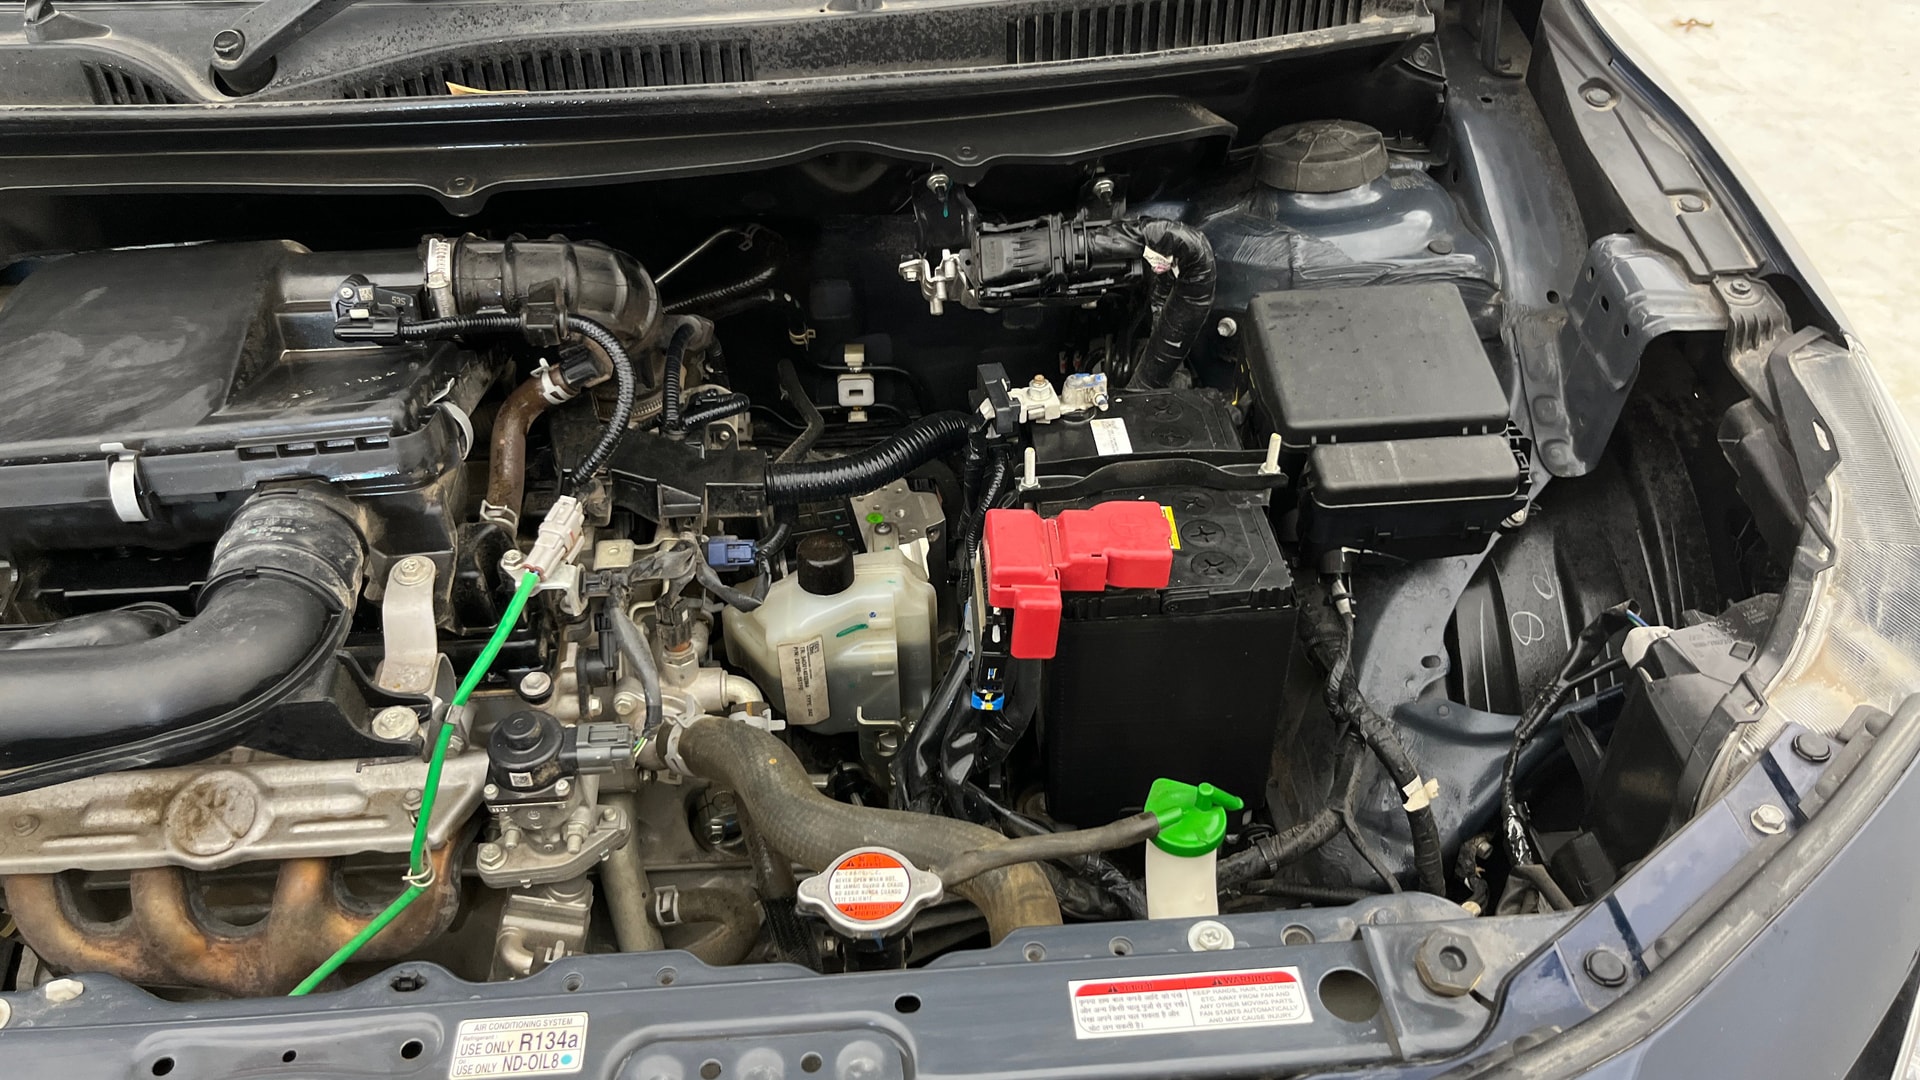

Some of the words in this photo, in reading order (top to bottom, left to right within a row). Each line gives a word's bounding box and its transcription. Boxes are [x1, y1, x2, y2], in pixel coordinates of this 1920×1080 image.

[1223, 974, 1273, 985] WARNING
[1243, 1005, 1298, 1014] AUTOMATICALLY
[474, 1024, 487, 1032] AIR
[488, 1020, 541, 1031] CONDITIONING
[543, 1018, 573, 1027] SYSTEM
[460, 1043, 482, 1056] USE
[485, 1040, 515, 1054] ONLY
[520, 1030, 578, 1051] R134a
[456, 1064, 473, 1076] USE
[475, 1062, 498, 1074] ONLY
[502, 1053, 559, 1072] ND-OIL8
